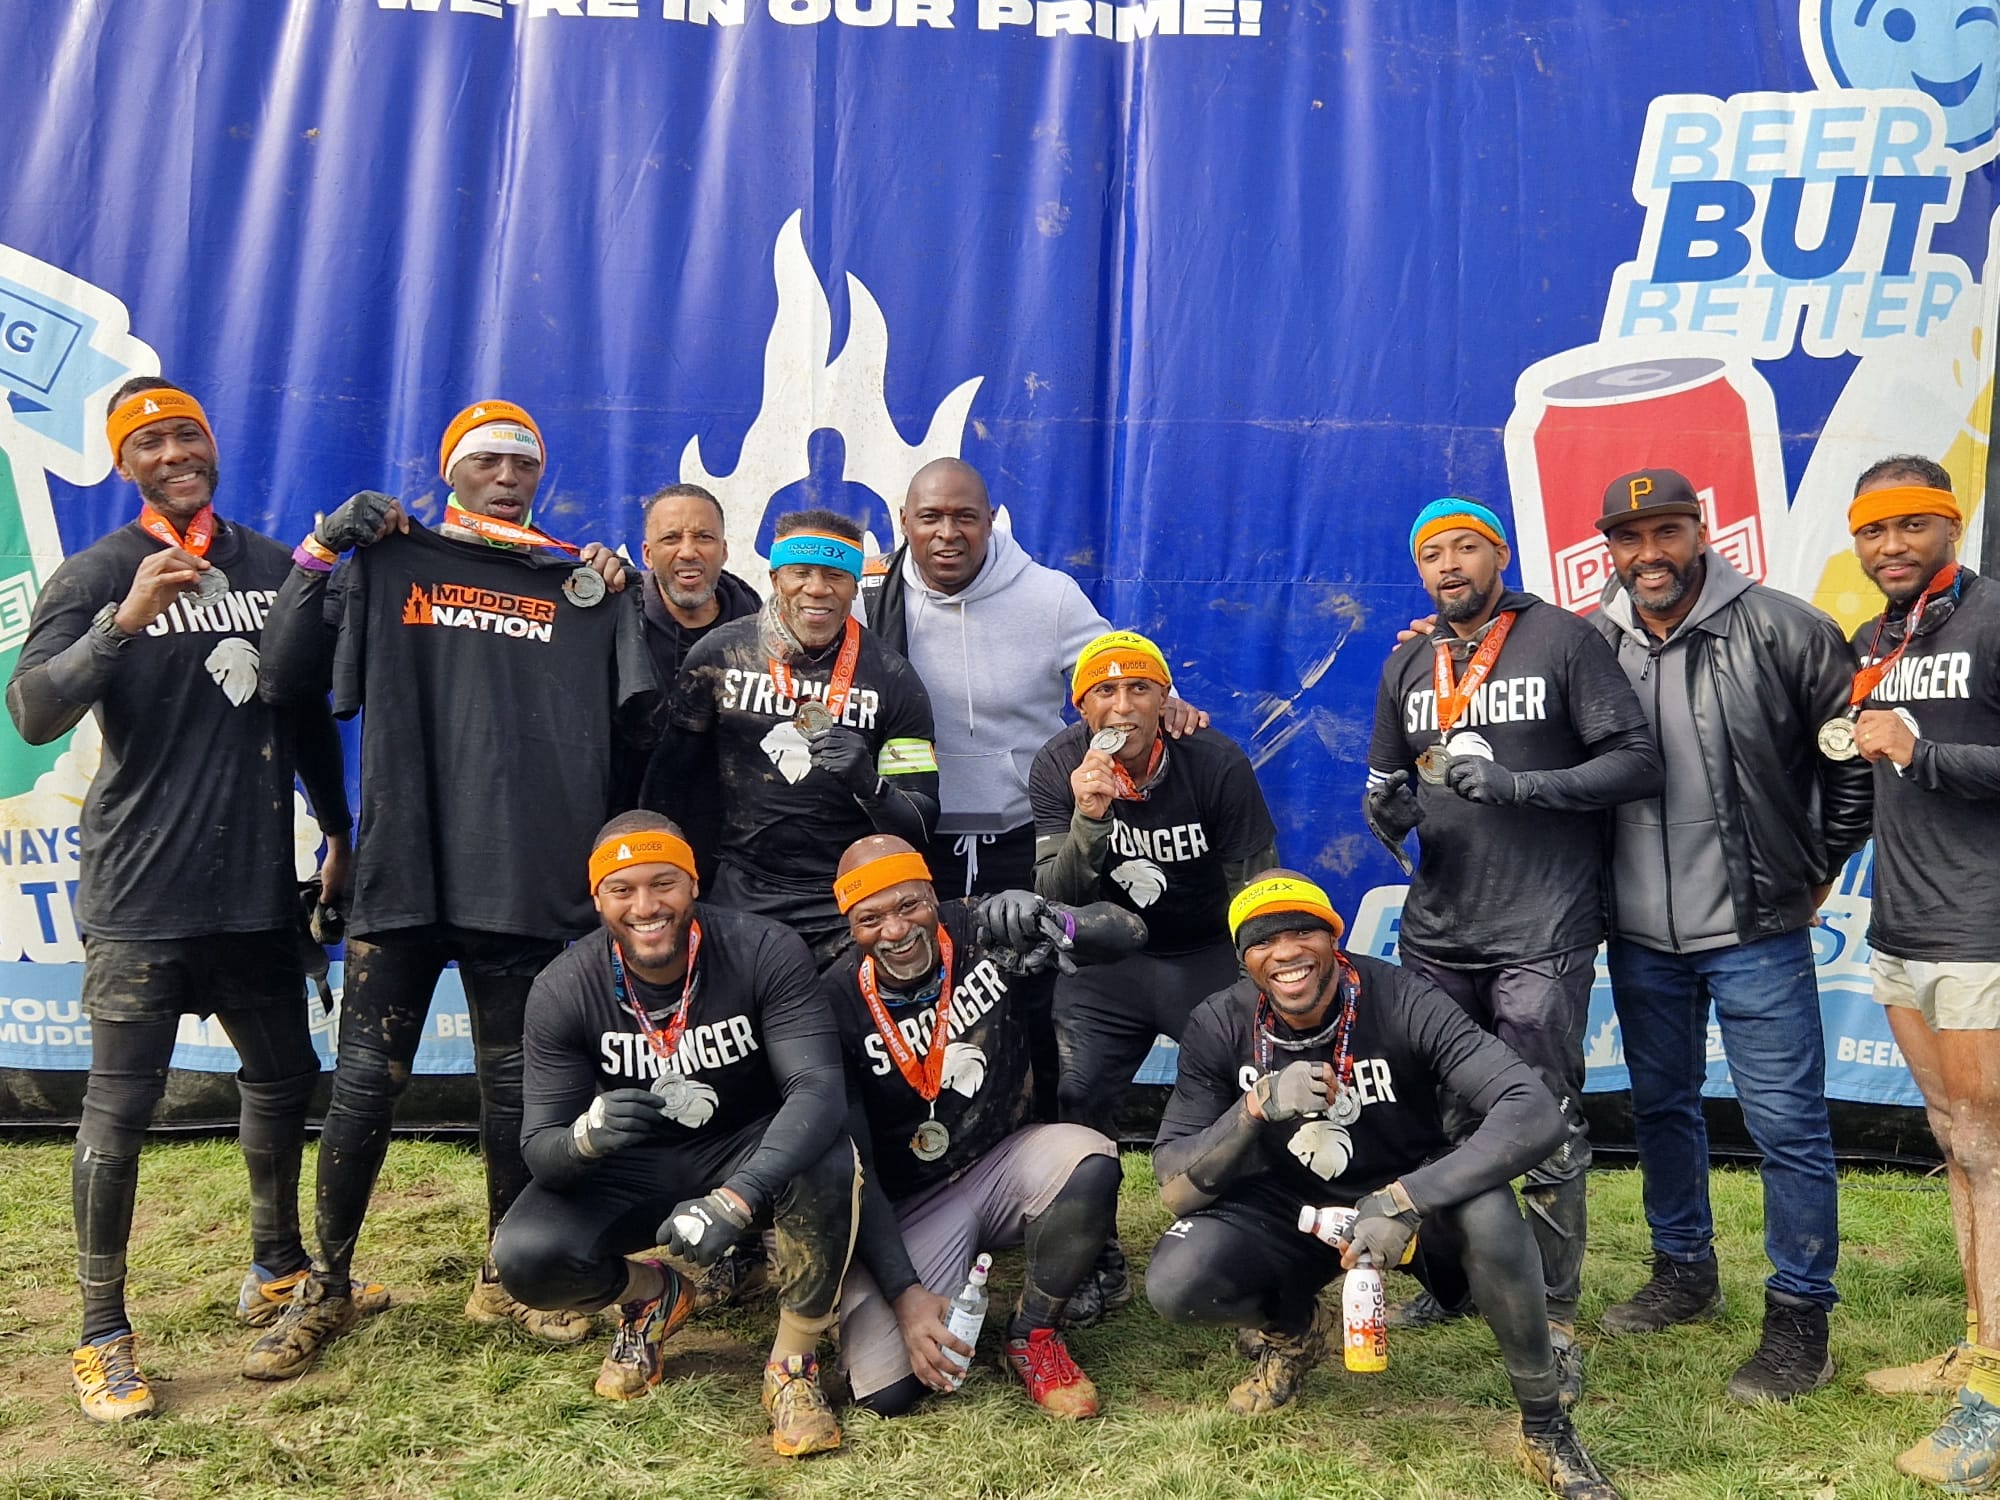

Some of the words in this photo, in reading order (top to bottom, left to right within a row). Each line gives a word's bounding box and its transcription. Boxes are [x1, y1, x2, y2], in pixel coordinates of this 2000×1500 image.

[769, 0, 954, 29] OUR
[978, 0, 1262, 43] PRIME!
[1650, 175, 1951, 284] BUT
[822, 546, 847, 561] 3X
[437, 587, 552, 619] MUDDER
[432, 605, 553, 643] NATION
[1267, 883, 1293, 891] 4X
[861, 960, 872, 991] 15K
[867, 993, 910, 1063] FINISHER
[1371, 1282, 1385, 1357] EMERGE
